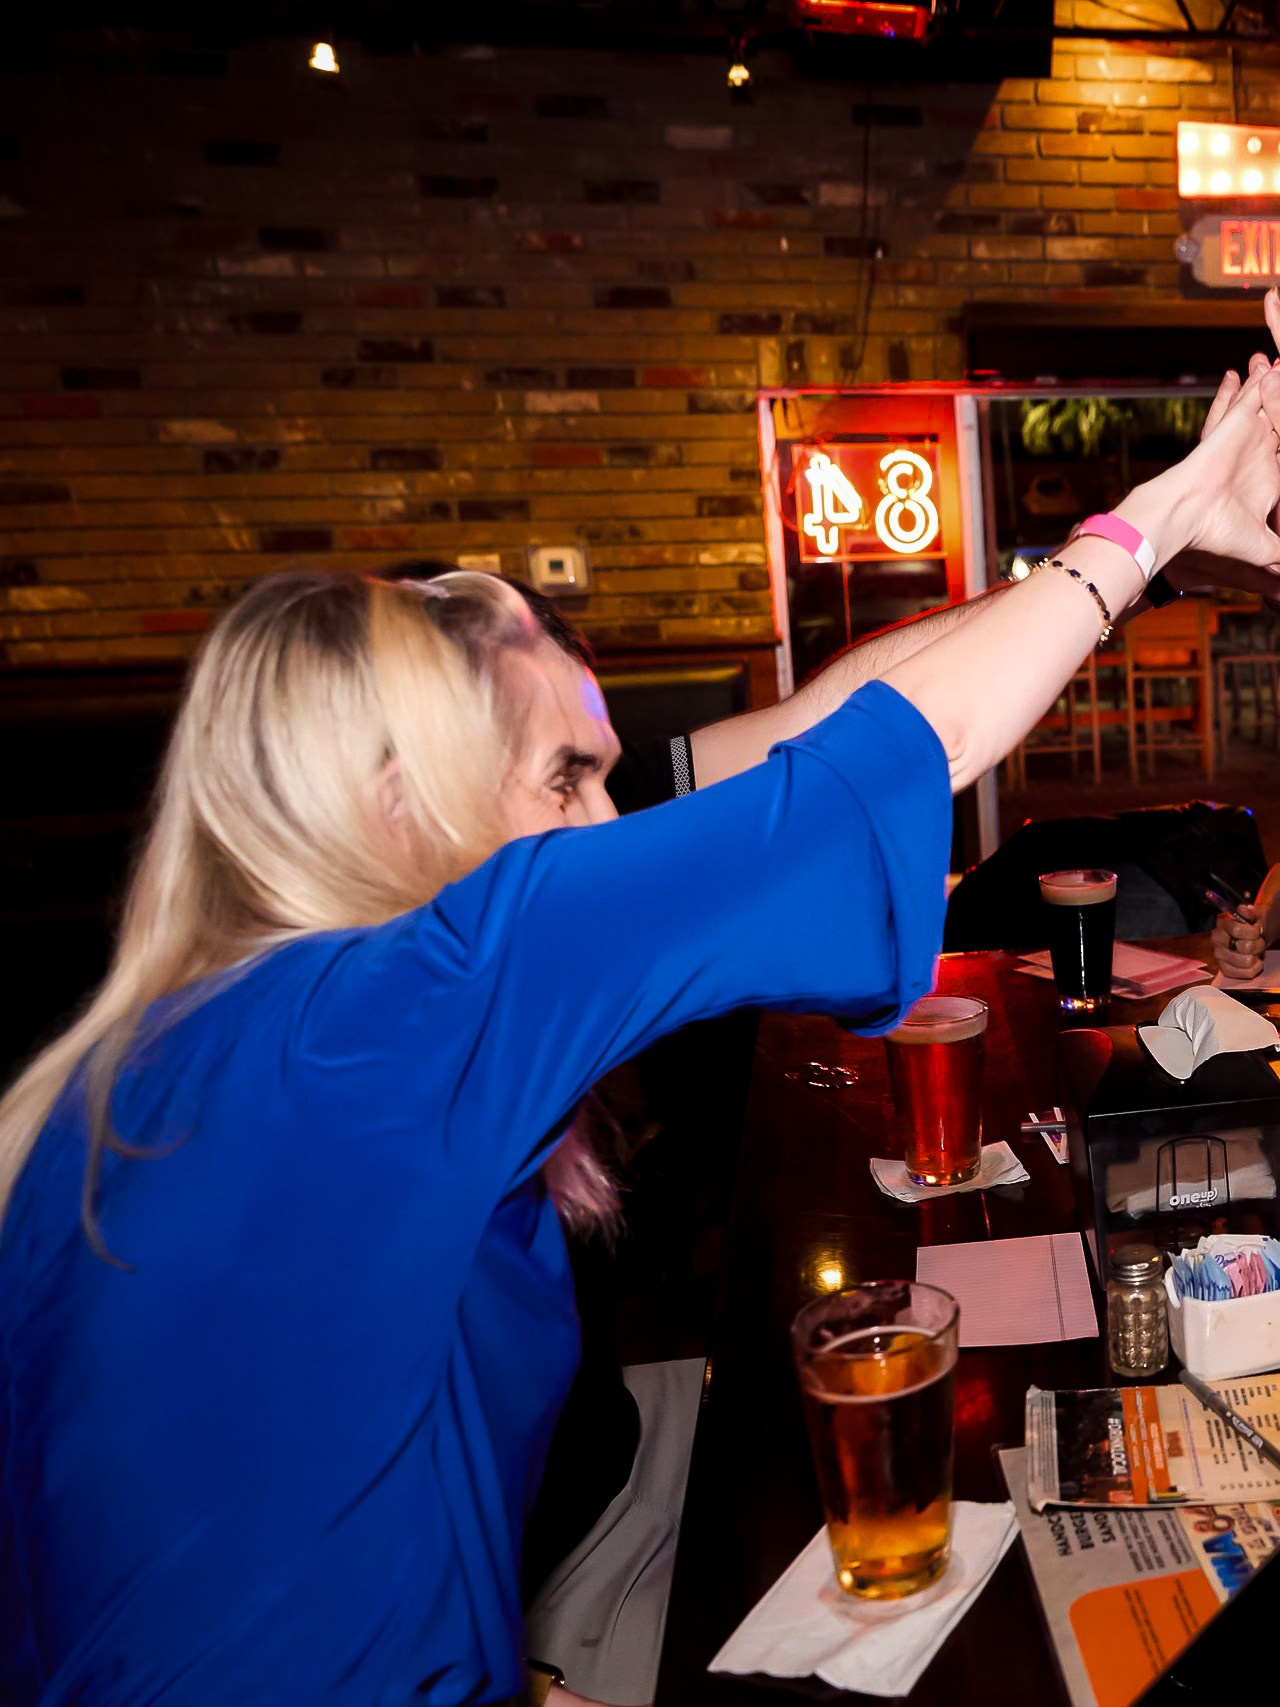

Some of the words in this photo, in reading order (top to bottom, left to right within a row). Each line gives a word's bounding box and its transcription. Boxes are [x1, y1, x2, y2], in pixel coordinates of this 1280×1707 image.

[1107, 1418, 1128, 1475] #DRINKLOCAL
[1045, 1516, 1072, 1557] HANDC
[1068, 1511, 1094, 1549] BURGE
[1093, 1512, 1115, 1543] SAND
